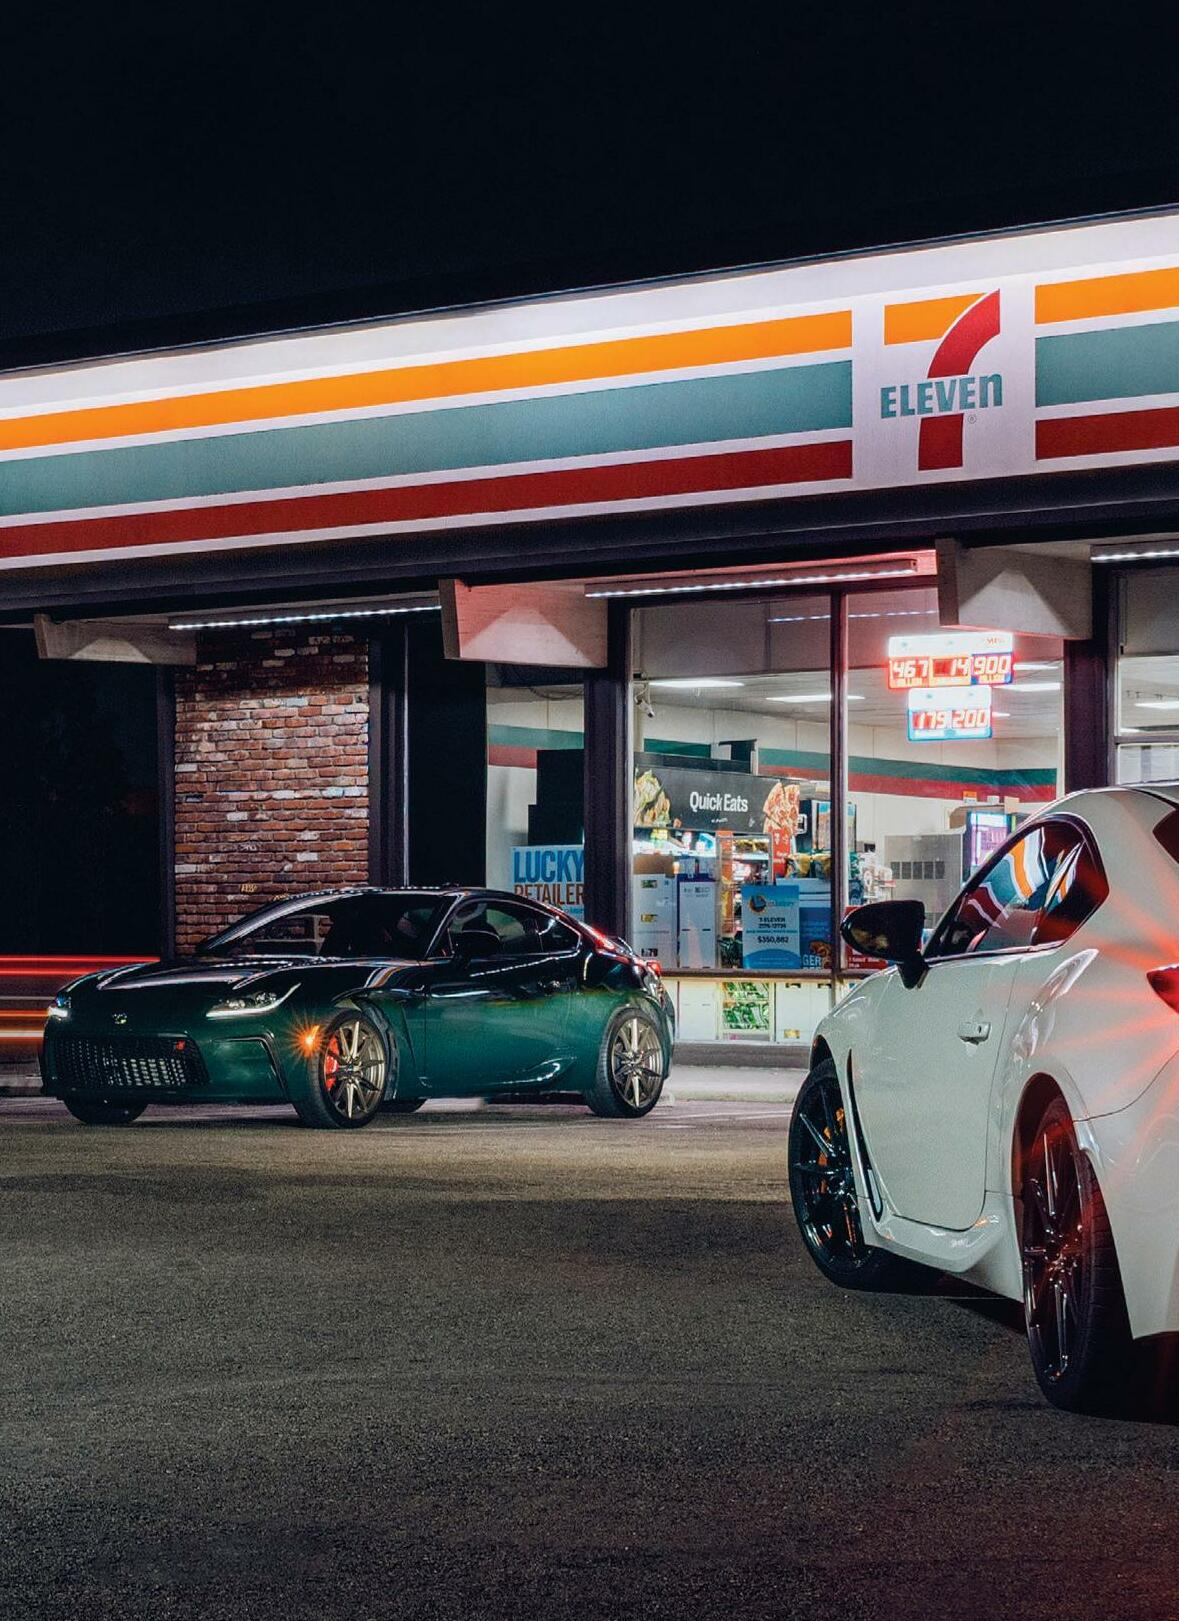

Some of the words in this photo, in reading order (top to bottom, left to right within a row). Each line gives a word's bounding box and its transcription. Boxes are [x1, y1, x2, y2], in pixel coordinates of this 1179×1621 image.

[974, 655, 1008, 675] 900
[690, 791, 723, 812] Quick
[723, 793, 749, 812] Eats
[514, 850, 585, 883] LUCKY
